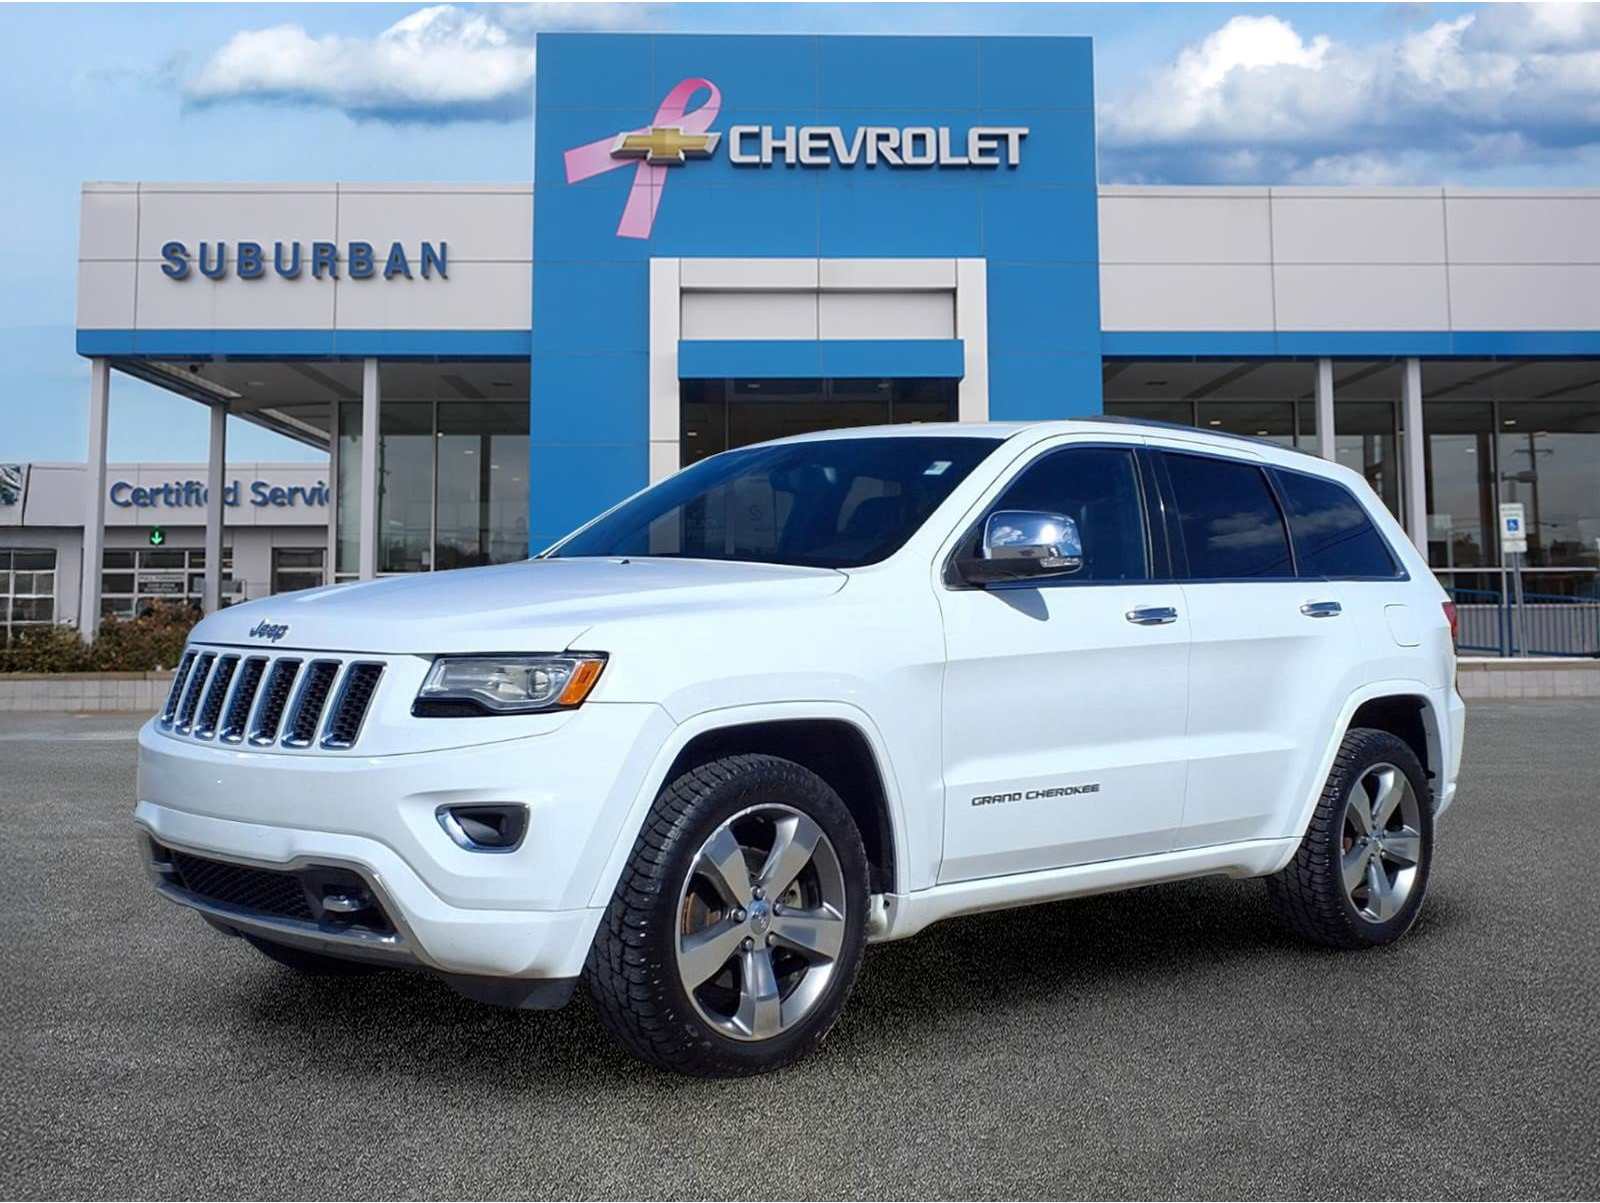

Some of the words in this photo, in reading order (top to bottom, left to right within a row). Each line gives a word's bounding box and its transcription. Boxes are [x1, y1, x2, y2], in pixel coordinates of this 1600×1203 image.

[729, 125, 1029, 166] CHEVROLET
[161, 241, 449, 281] SUBURBAN
[110, 481, 240, 507] Certifid
[250, 481, 330, 507] Servi
[249, 618, 289, 643] Jeep
[971, 792, 1022, 806] GRAND
[1025, 784, 1100, 800] CHEROKEE
